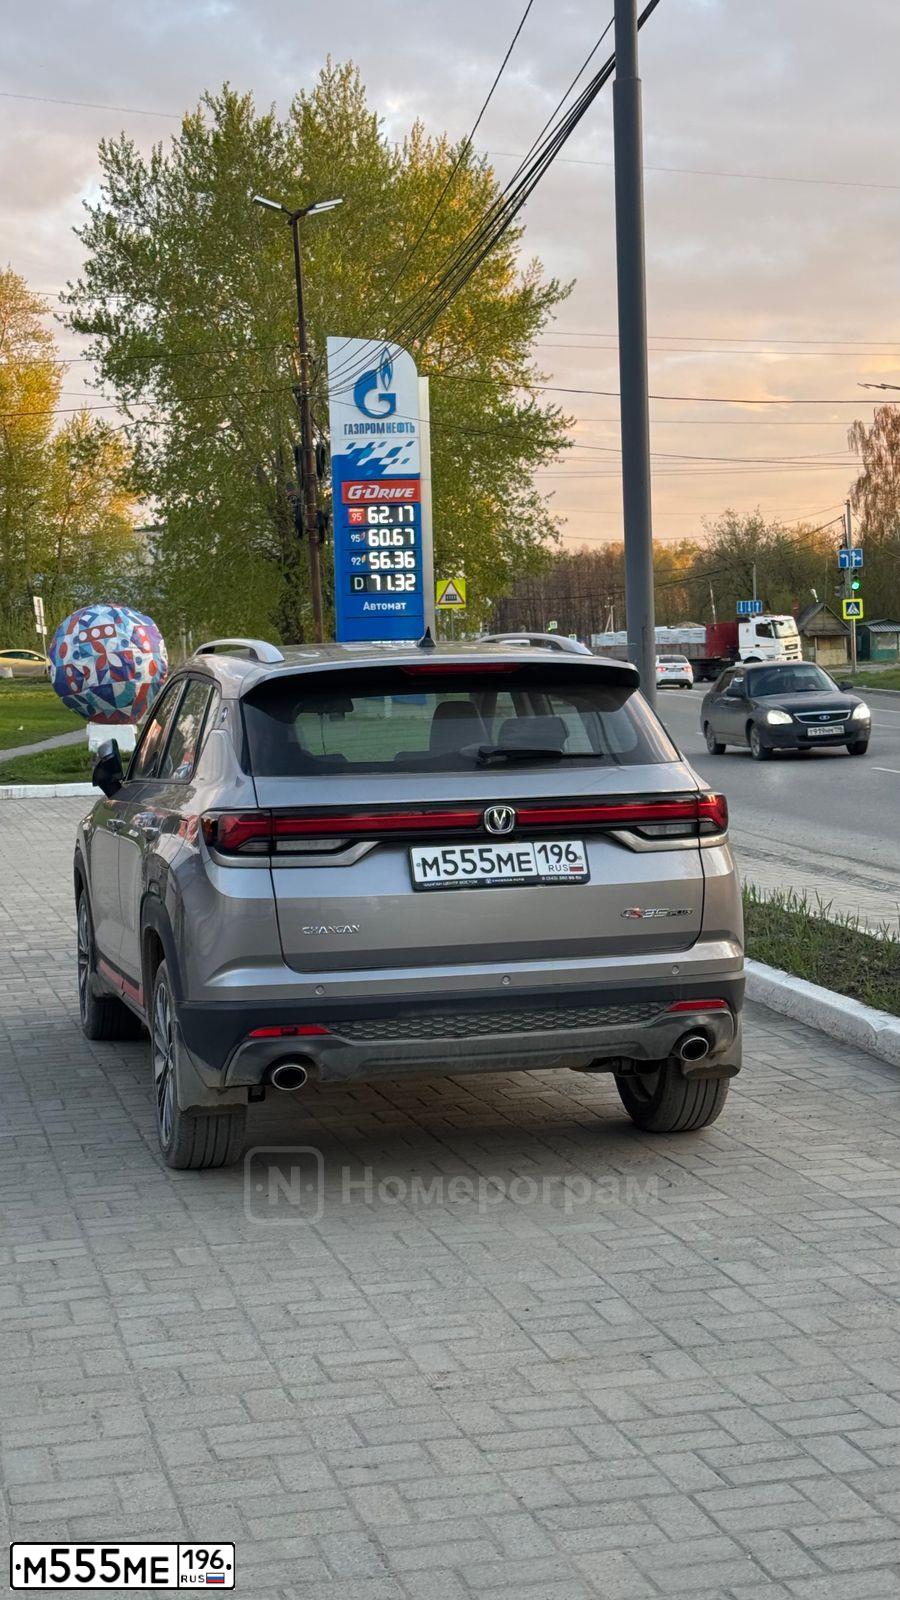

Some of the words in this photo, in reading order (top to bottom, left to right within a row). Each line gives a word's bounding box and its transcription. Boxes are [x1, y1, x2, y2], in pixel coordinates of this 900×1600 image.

[344, 422, 415, 435] ГАЗПРОМНЕФТЬ
[351, 512, 362, 521] 95
[367, 505, 414, 524] 62.17
[350, 534, 361, 542] 95
[368, 528, 415, 547] 60.67
[351, 557, 361, 566] 92
[369, 551, 416, 569] 56.36
[354, 577, 364, 590] D
[370, 573, 416, 591] 71.32
[363, 601, 407, 611] Автомат
[421, 848, 533, 878] М555МЕ
[537, 843, 578, 864] 196
[548, 864, 568, 872] RUS
